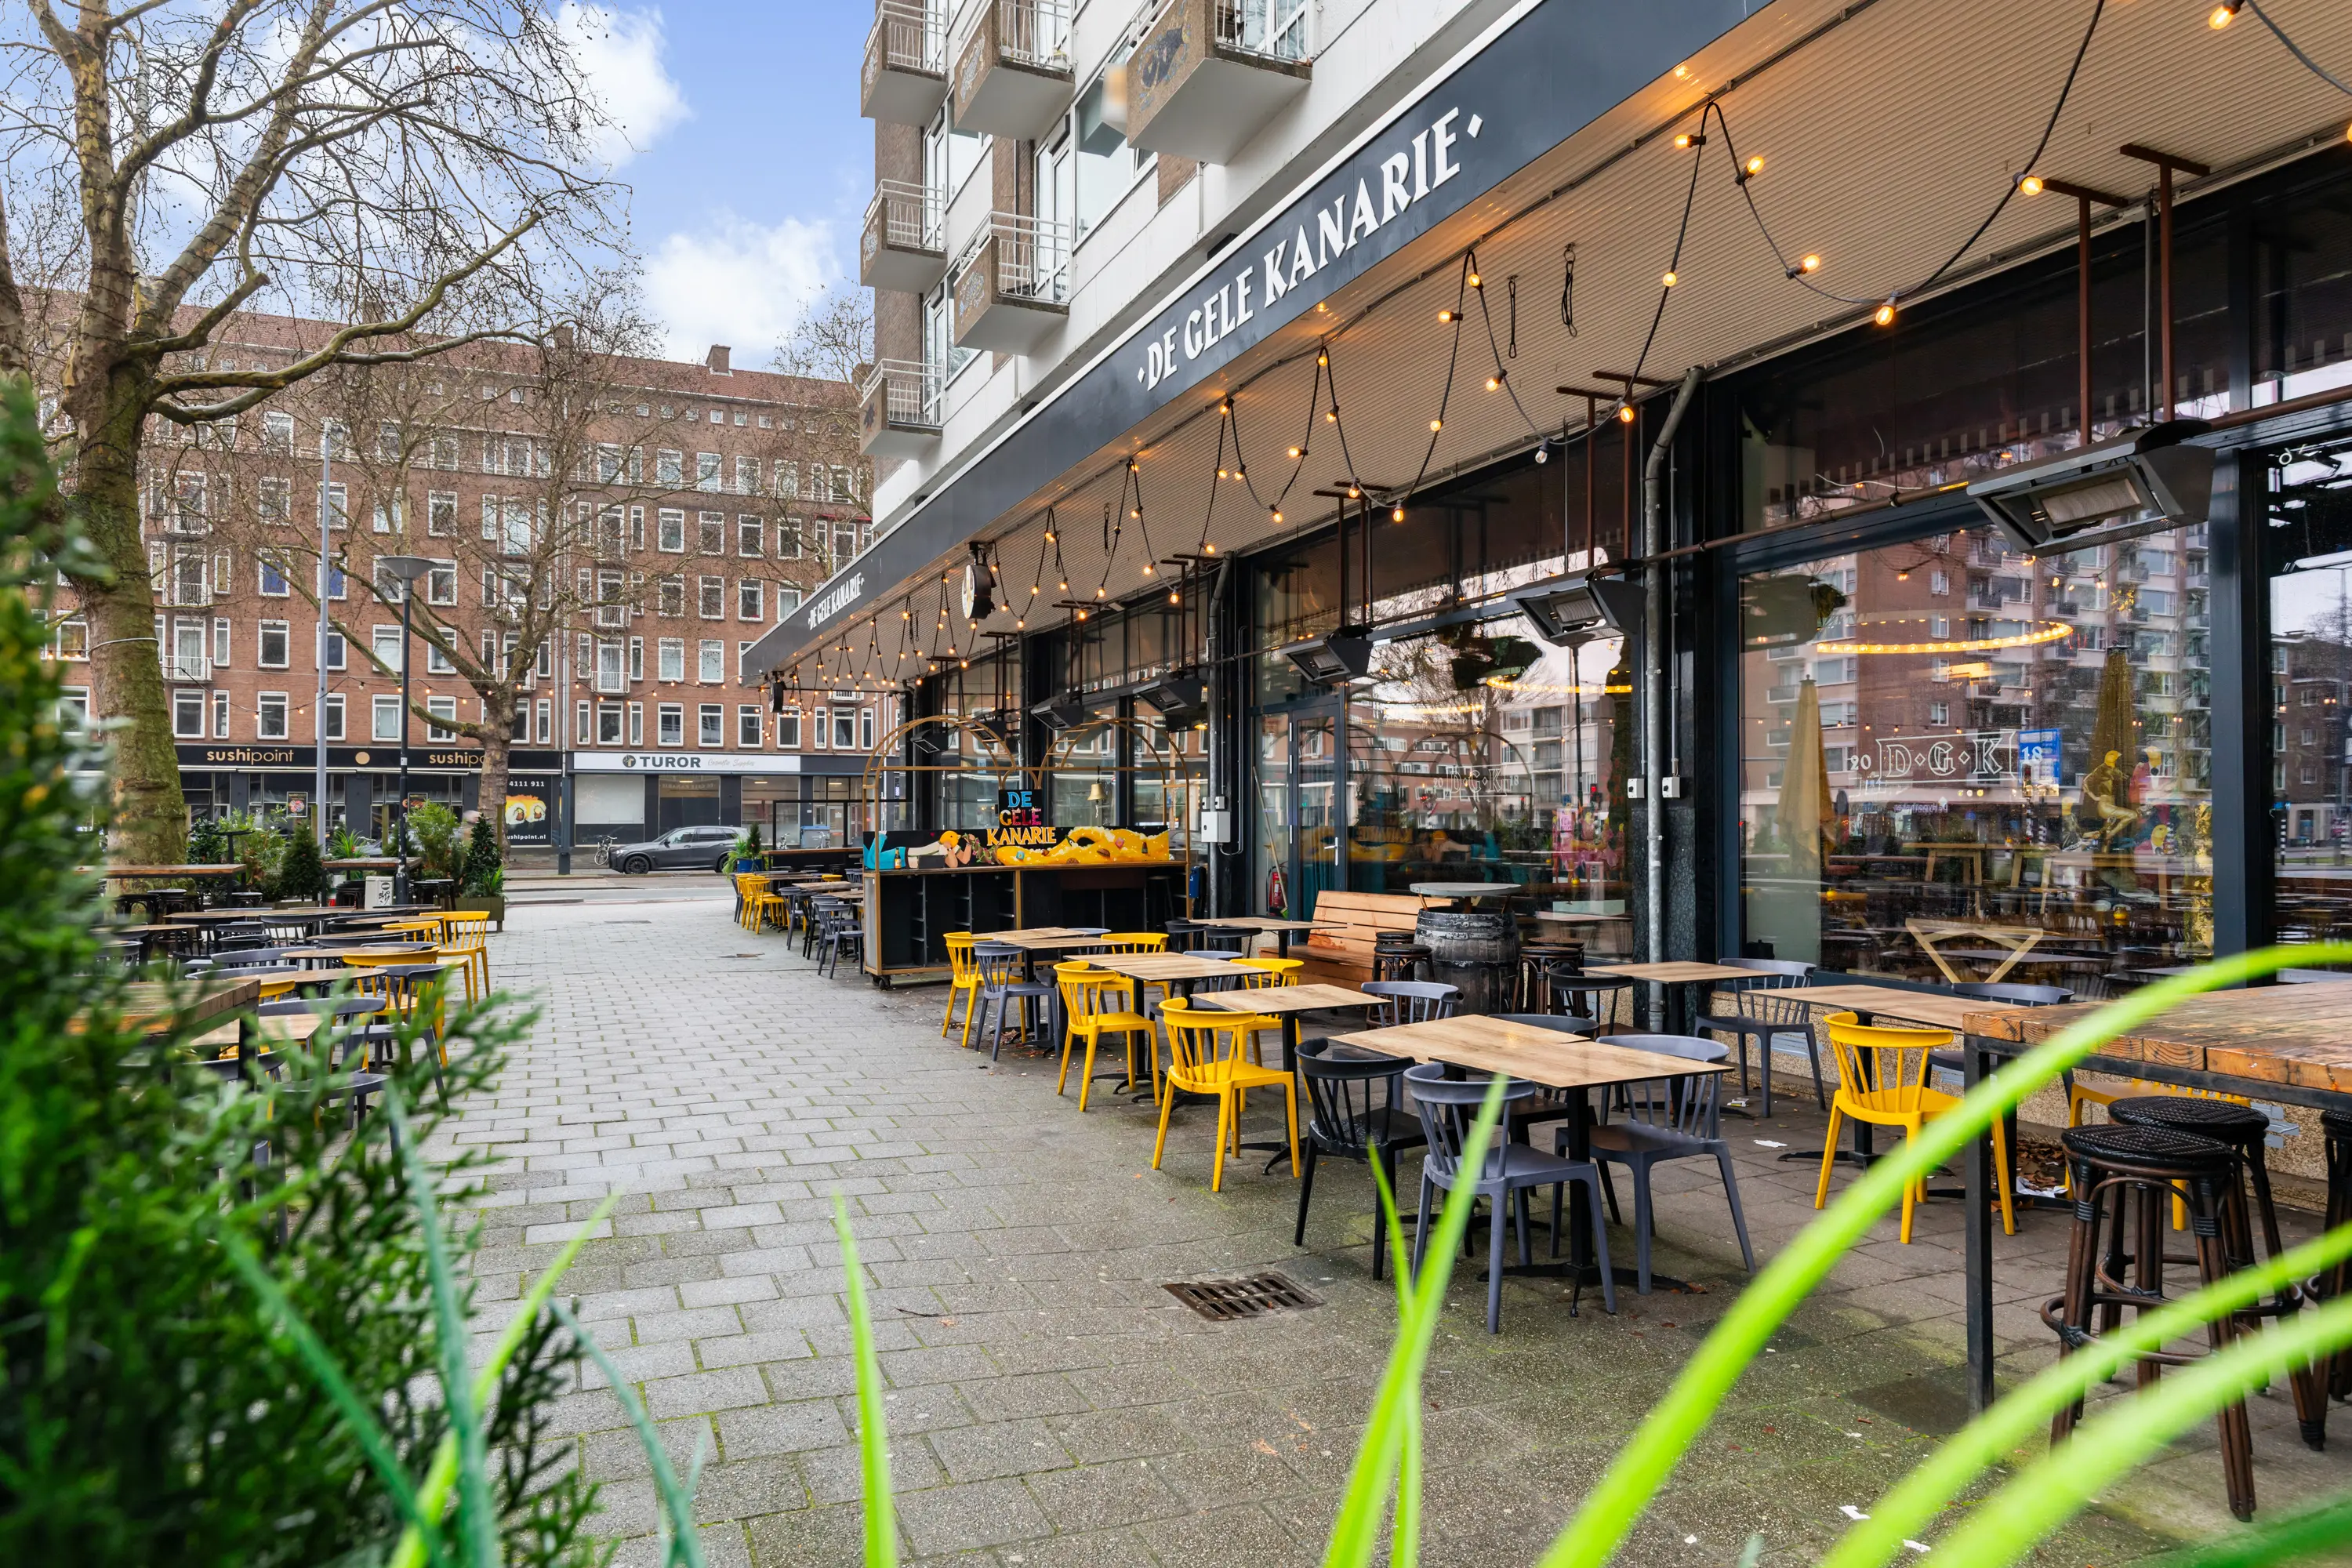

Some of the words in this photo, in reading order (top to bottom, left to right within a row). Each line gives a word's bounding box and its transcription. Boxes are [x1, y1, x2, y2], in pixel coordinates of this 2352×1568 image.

[1147, 325, 1178, 392] DE
[1184, 266, 1255, 361] GELE
[1264, 107, 1461, 309] KANARIE
[810, 606, 817, 630] DE
[818, 595, 831, 624] GELE
[831, 572, 862, 615] KANARIE
[207, 748, 294, 765] sushipoint
[640, 756, 701, 768] TUROR
[1850, 754, 1871, 770] 20
[2021, 746, 2043, 763] 18
[1007, 791, 1032, 808] DE
[999, 808, 1041, 826] GELE
[987, 826, 1056, 846] KANARIE
